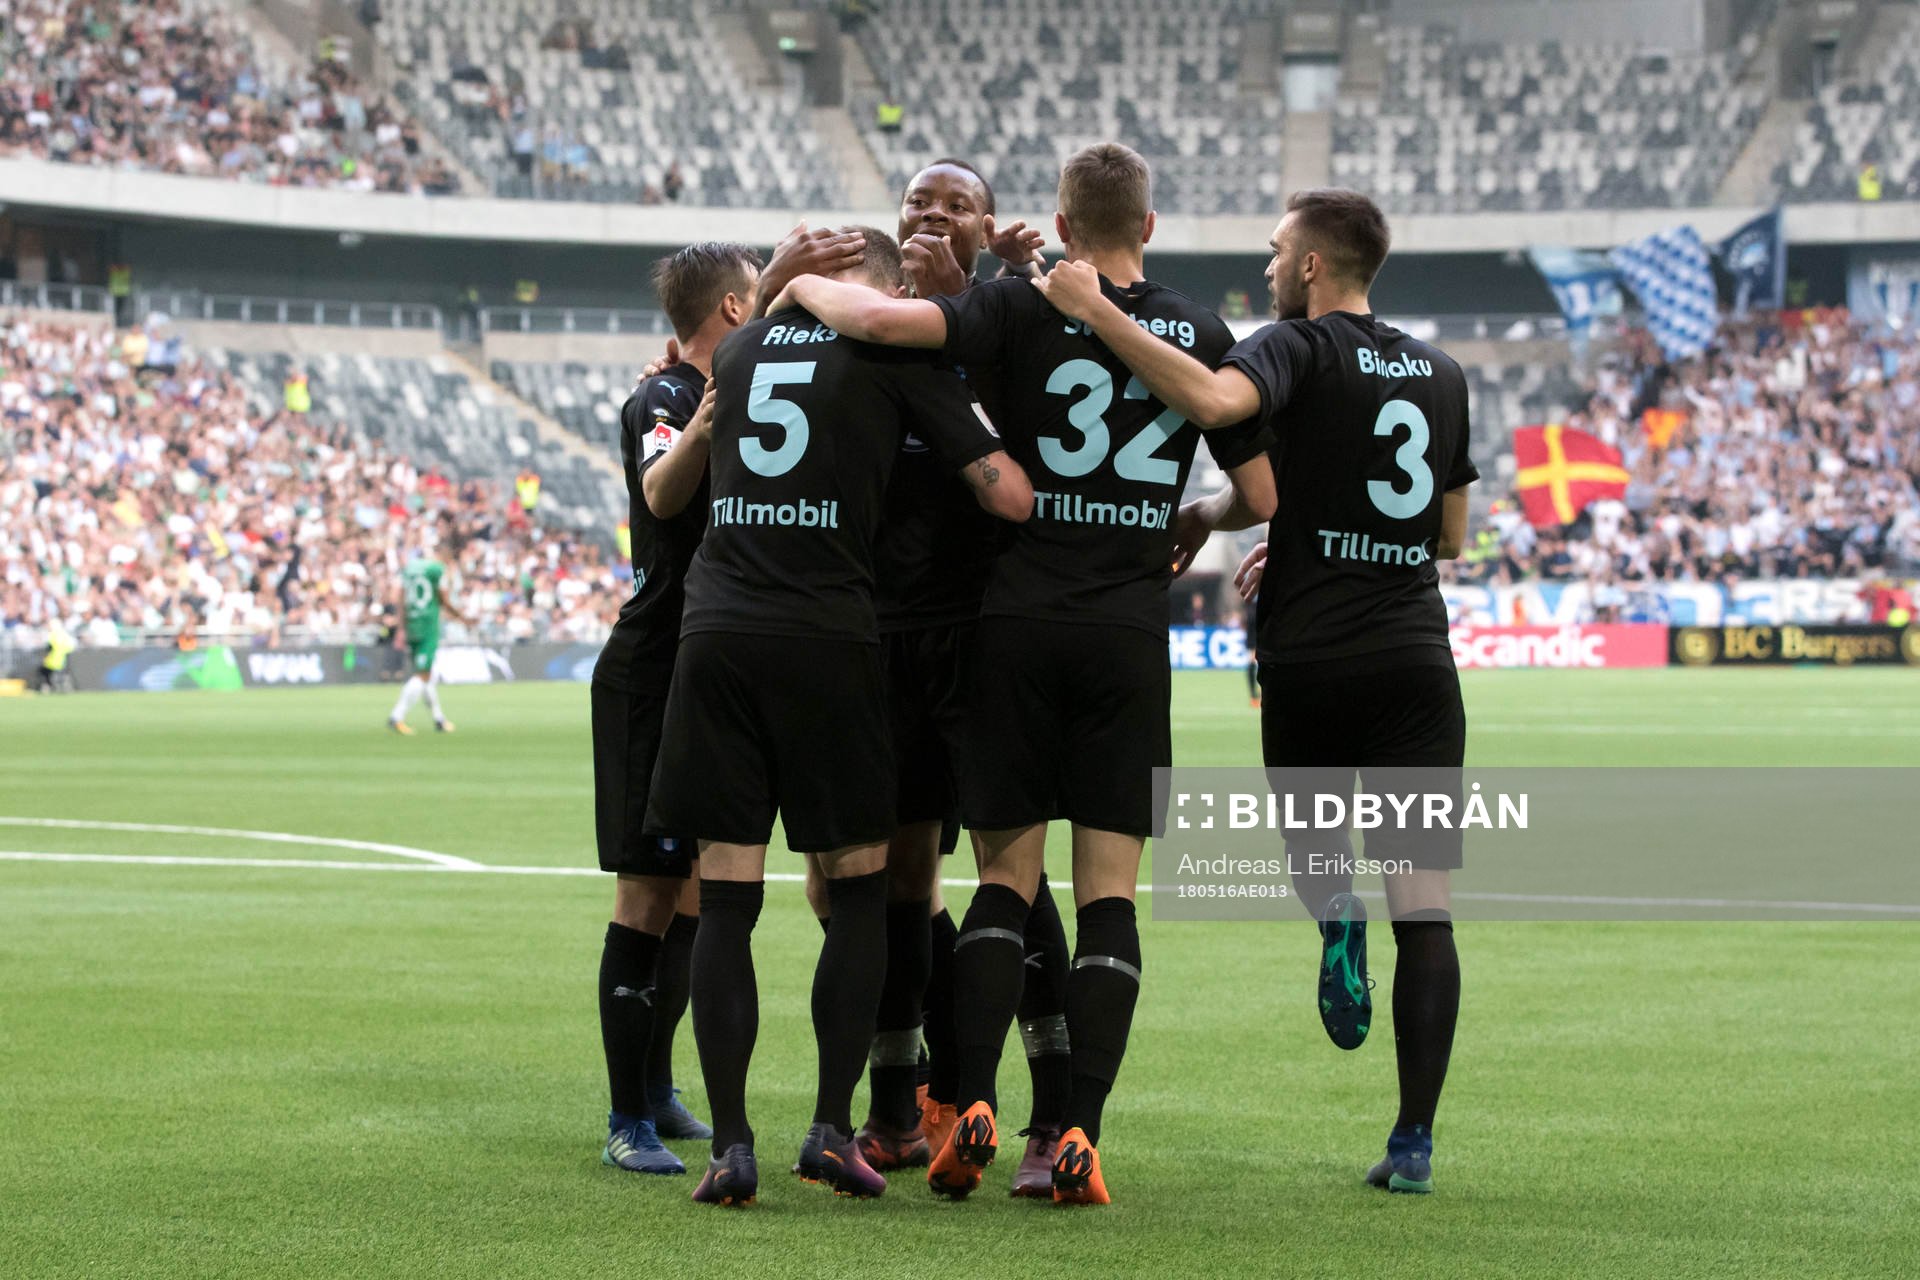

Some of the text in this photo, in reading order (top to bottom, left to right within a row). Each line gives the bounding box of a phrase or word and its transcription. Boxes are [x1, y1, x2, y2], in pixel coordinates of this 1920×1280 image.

[1357, 347, 1433, 378] Binaku
[738, 361, 817, 477] 5
[1037, 358, 1187, 485] 32
[1367, 399, 1434, 519] 3
[712, 496, 839, 529] Tillmobil
[1032, 490, 1171, 530] Tillmobil
[1450, 624, 1606, 667] Scandic
[1724, 626, 1896, 666] BC Burgers
